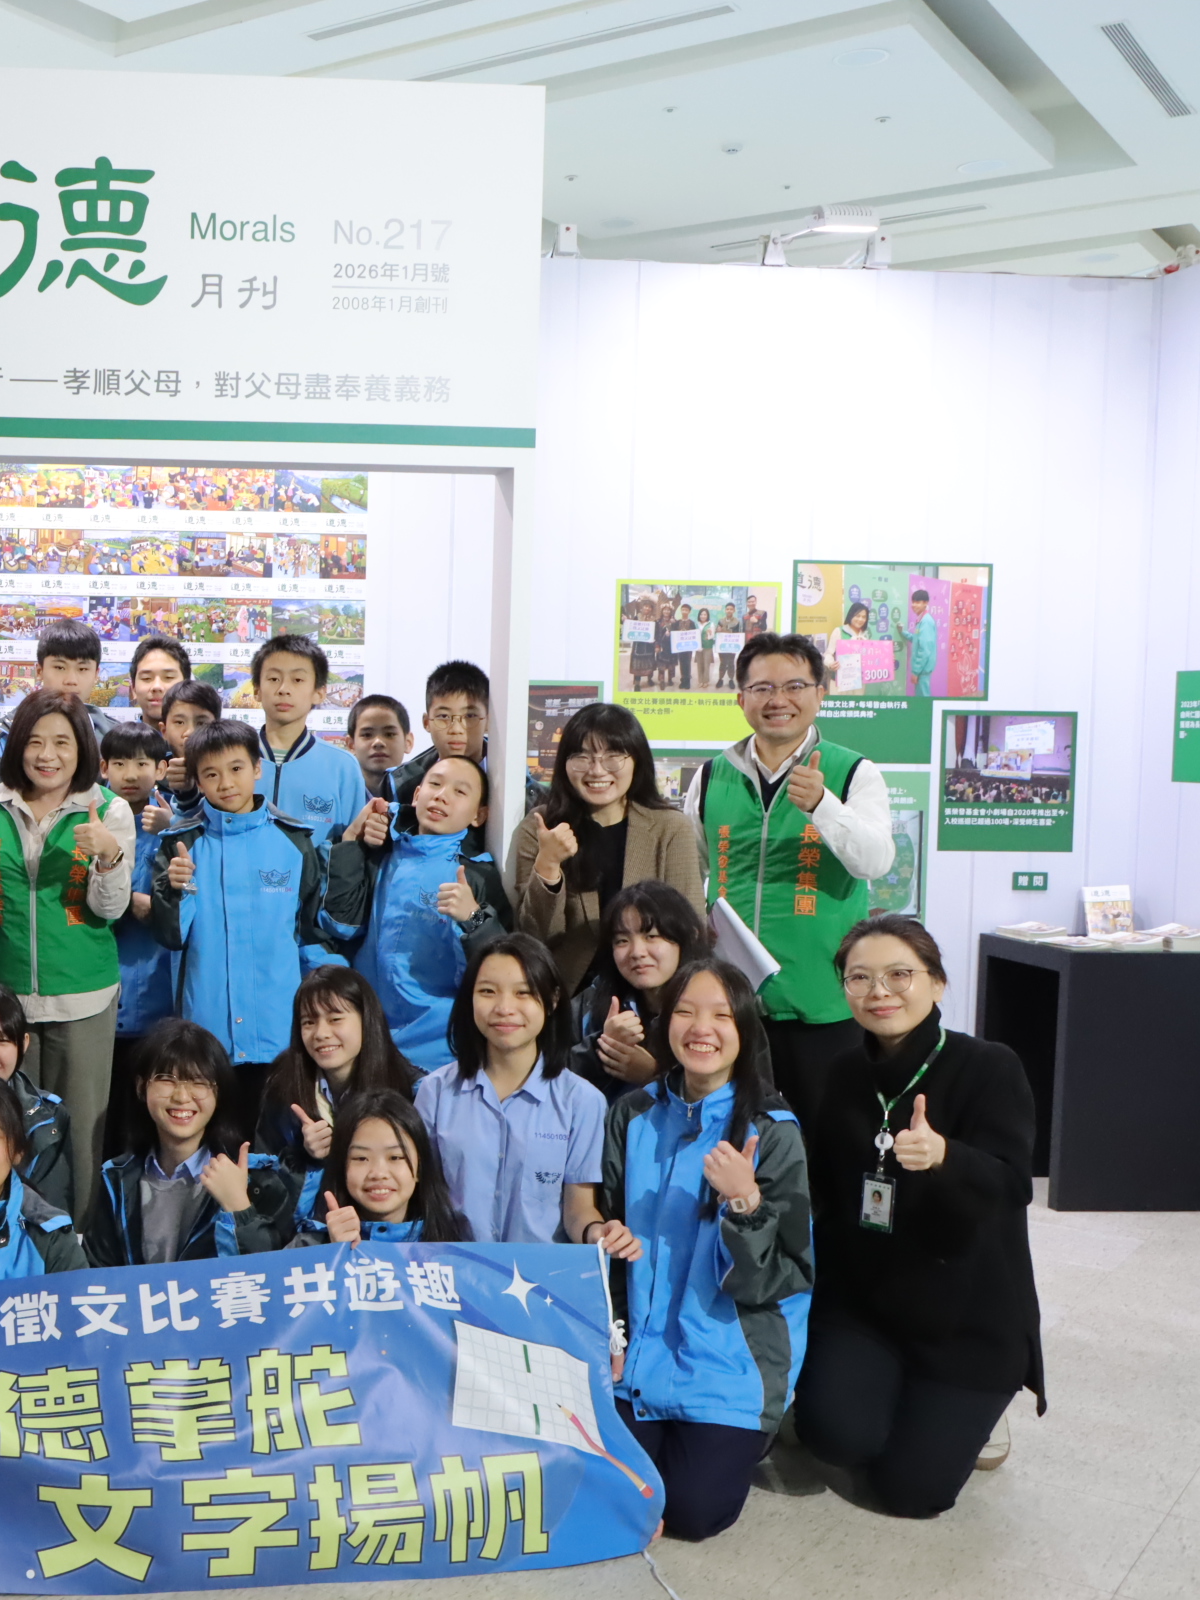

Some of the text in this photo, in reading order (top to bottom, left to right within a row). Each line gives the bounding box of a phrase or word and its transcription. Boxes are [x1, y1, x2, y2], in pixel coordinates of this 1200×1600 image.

[190, 212, 296, 243] Morals
[333, 218, 453, 251] No.217
[332, 262, 450, 284] 2026年1月號
[191, 274, 278, 310] 月刊
[332, 295, 449, 314] 2008年1月創刊
[864, 668, 889, 681] 3000
[794, 824, 822, 916] 長榮集團
[35, 1450, 551, 1582] 文字揚帆
